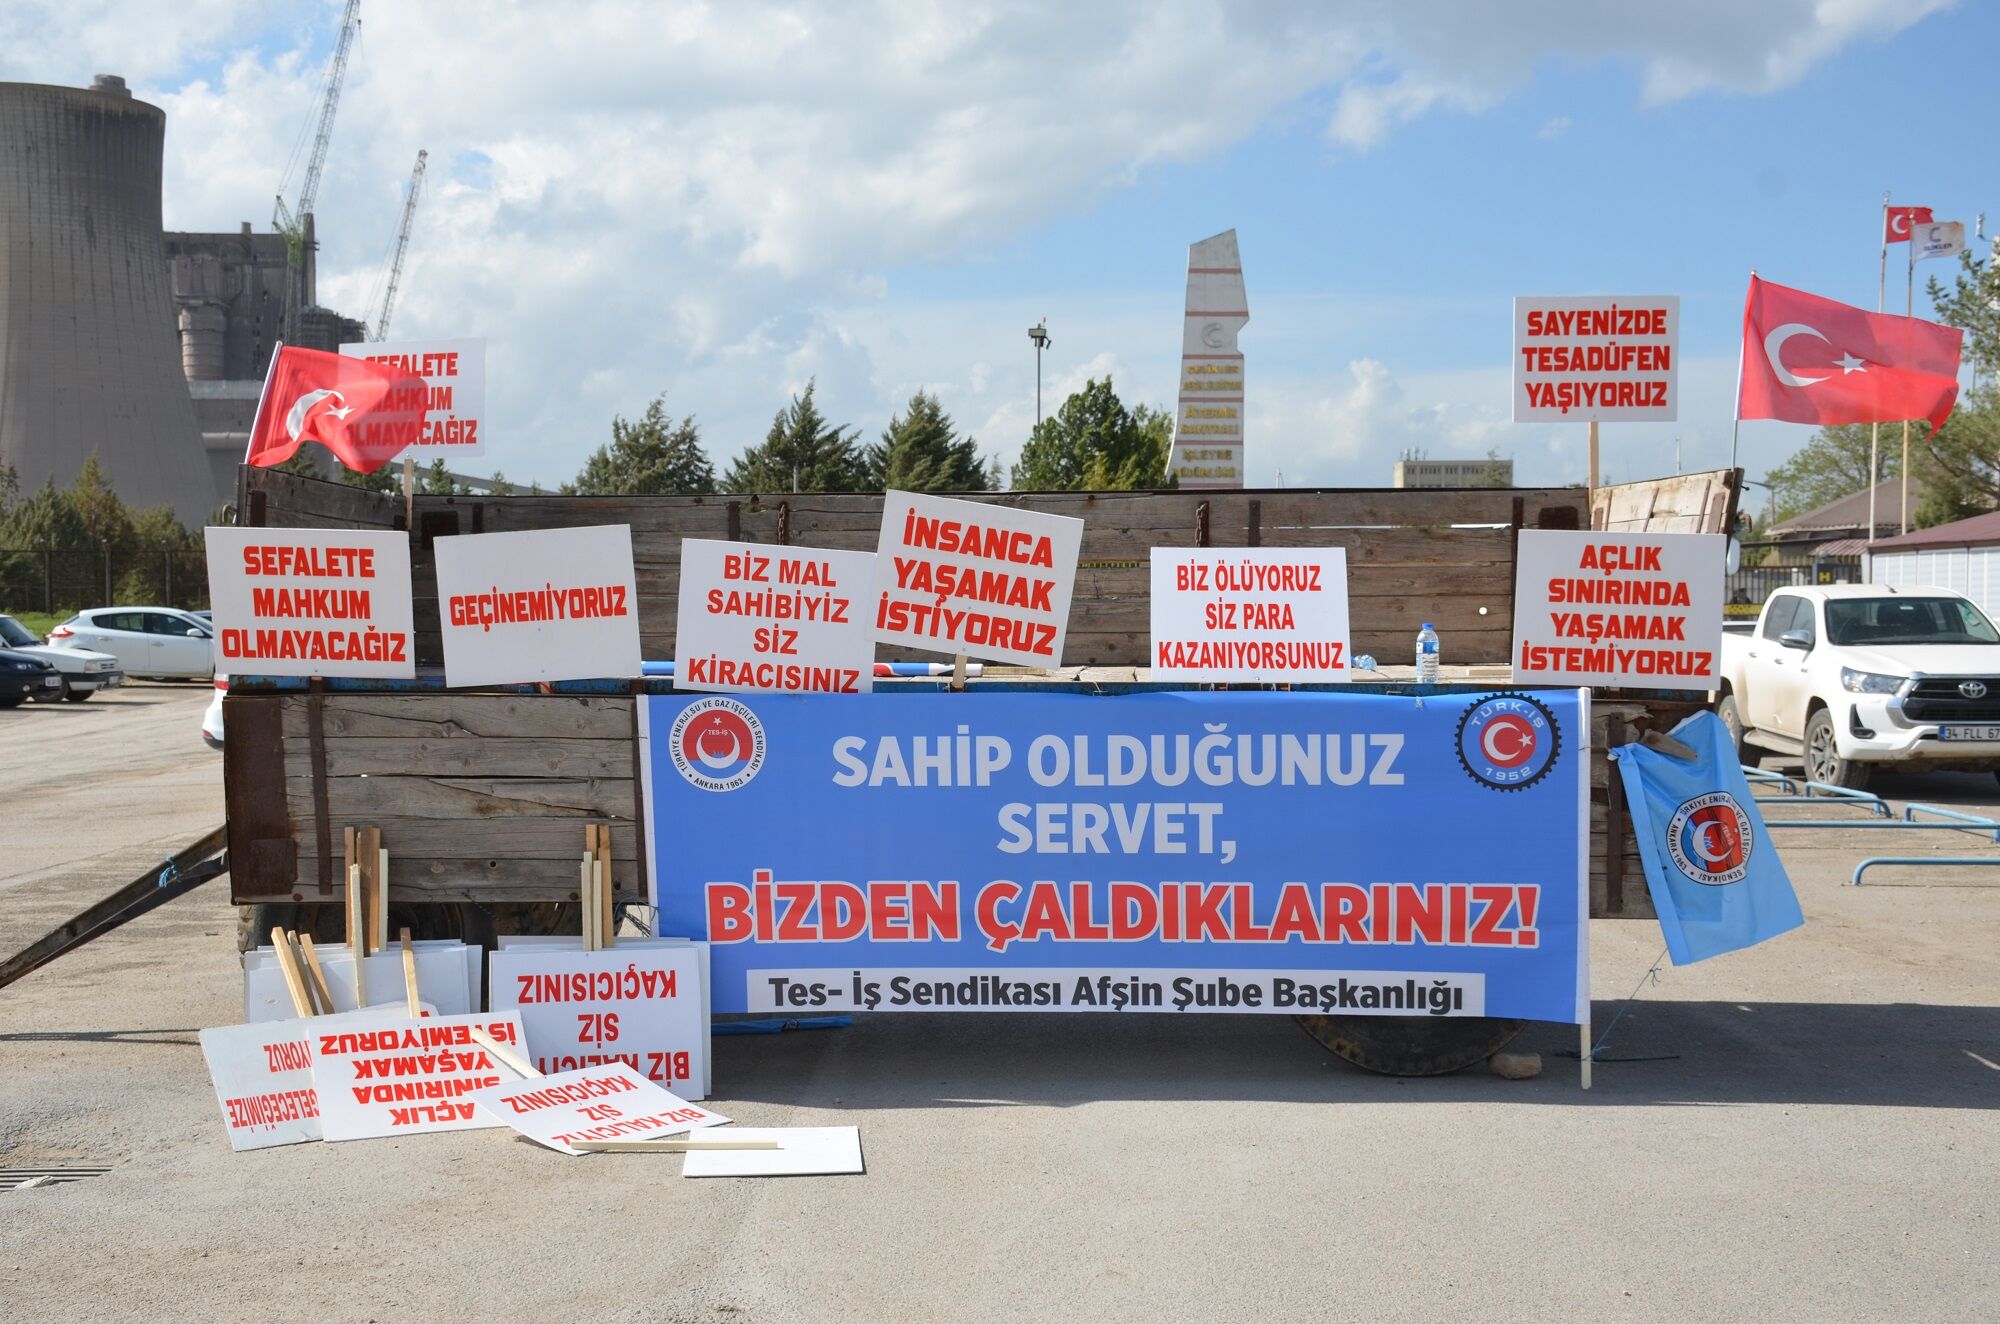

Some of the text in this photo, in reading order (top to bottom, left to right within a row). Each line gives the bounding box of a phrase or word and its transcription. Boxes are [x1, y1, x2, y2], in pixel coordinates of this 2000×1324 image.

[1527, 304, 1668, 336] SAYENİZDE
[1521, 342, 1670, 372] TESADÜFEN
[1525, 382, 1668, 414] YAŞIYORUZ
[903, 507, 1054, 569] İNSANCA
[243, 545, 376, 579] SEFALETE
[724, 550, 837, 588] BİZ MAL
[1176, 559, 1322, 592] BİZ ÖLÜYORUZ
[1579, 544, 1662, 576] AÇLIK
[893, 556, 1056, 612] YAŞAMAK
[1548, 578, 1691, 607] SINIRINDA
[252, 587, 371, 620] MAHKUM
[450, 583, 628, 633] GEÇİNEMİYORUZ
[707, 587, 850, 624] SAHİBİYİZ
[1205, 597, 1296, 630] SİZ PARA
[753, 623, 799, 656] SİZ
[876, 591, 1057, 657] İSTİYORUZ
[1551, 612, 1685, 645] YAŞAMAK
[221, 625, 407, 663] OLMAYACAĞIZ
[1158, 641, 1345, 670] KAZANIYORSUNUZ
[1521, 640, 1712, 677] İSTEMİYORUZ
[688, 656, 860, 693] KİRACISINIZ
[702, 700, 712, 709] VE
[714, 699, 730, 708] GAZ
[832, 723, 1405, 787] SAHİP OLDUĞUNUZ
[694, 777, 744, 790] ANKARA 1963
[1485, 766, 1533, 781] 1952
[997, 803, 1237, 864] SERVET,
[706, 870, 1541, 952] BİZDEN ÇALDIKLARINIZ!
[517, 963, 677, 1004] KAÇICISINIZ
[889, 975, 1061, 1006] Sendikası
[1071, 976, 1163, 1012] Afşin
[1171, 976, 1263, 1013] Şube
[1272, 978, 1463, 1016] Başkanlığı
[577, 1012, 620, 1049] SİZ
[352, 1049, 494, 1080] YAŞAMAK
[647, 1051, 690, 1087] BİZ
[389, 1101, 475, 1126] AÇLIK
[576, 1103, 623, 1121] SİZ
[659, 1107, 706, 1124] BİZ
